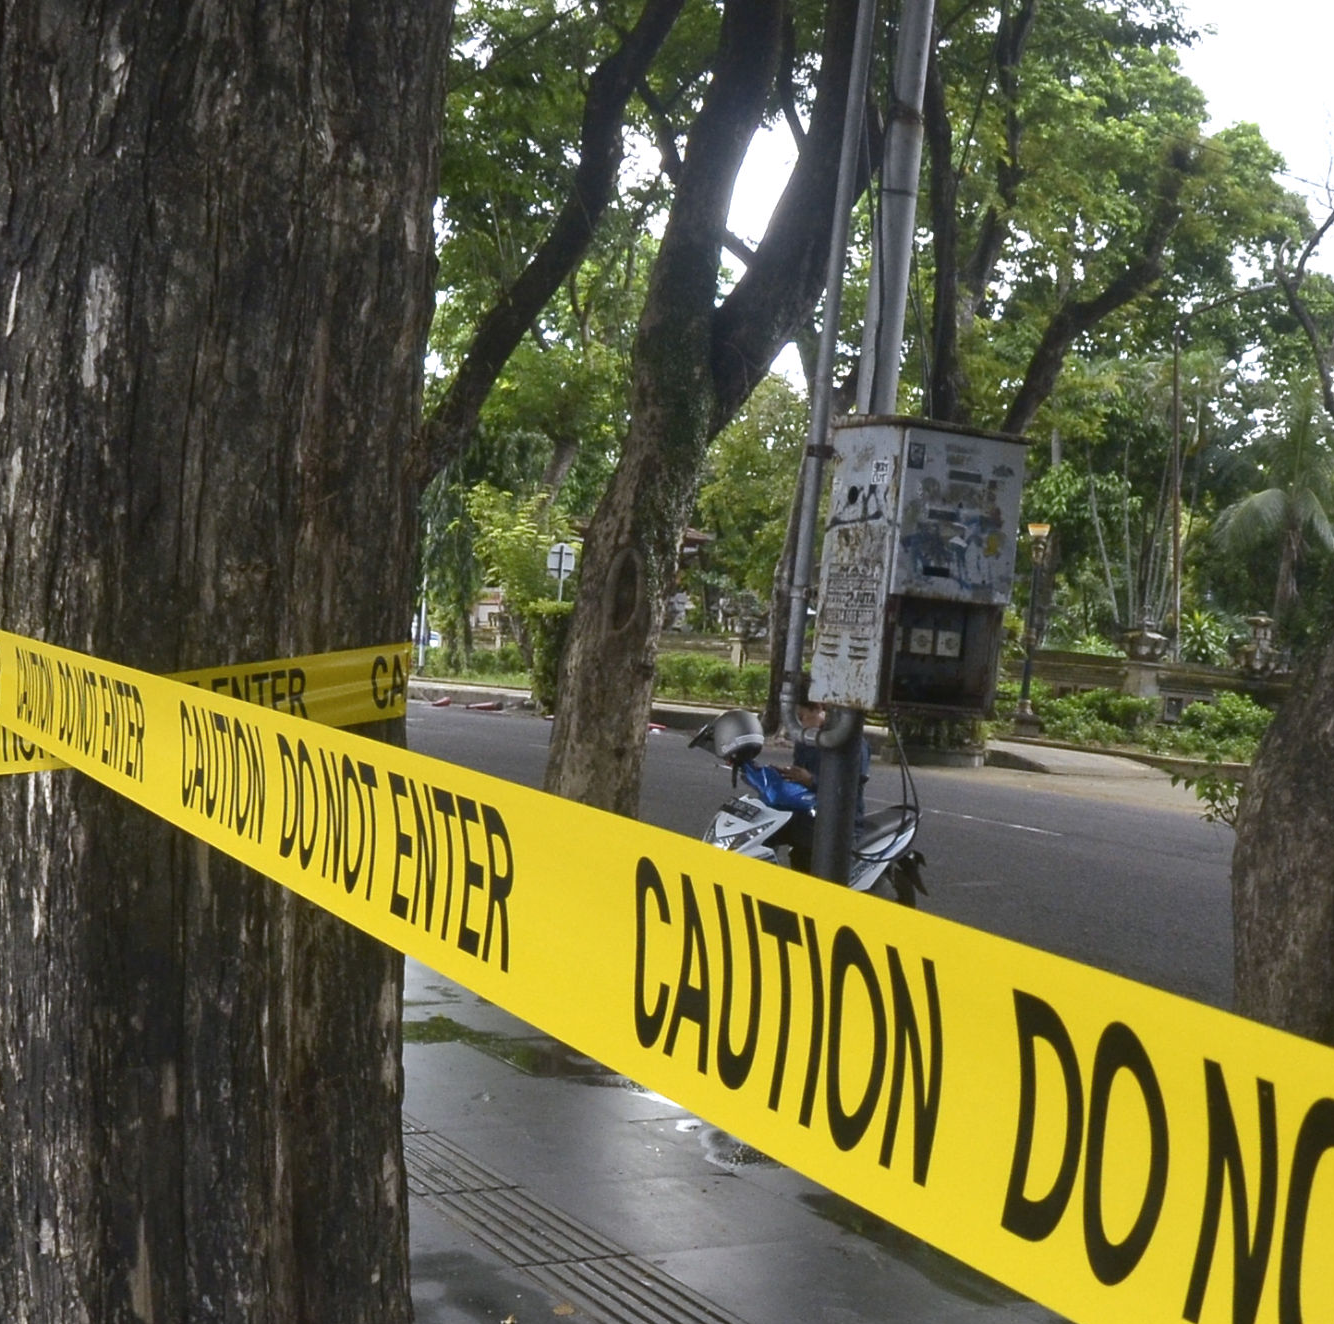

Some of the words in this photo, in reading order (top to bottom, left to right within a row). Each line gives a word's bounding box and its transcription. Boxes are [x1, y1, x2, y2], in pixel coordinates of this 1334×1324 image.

[16, 647, 54, 735] CAUTION
[58, 660, 76, 747] DO
[74, 666, 97, 758] NOT
[100, 674, 145, 783] ENTER
[180, 700, 266, 845] CAUTION
[277, 732, 319, 870] DO
[319, 747, 378, 901] NOT
[387, 771, 514, 974] ENTER
[635, 856, 944, 1188] CAUTION
[1001, 988, 1170, 1287] DO
